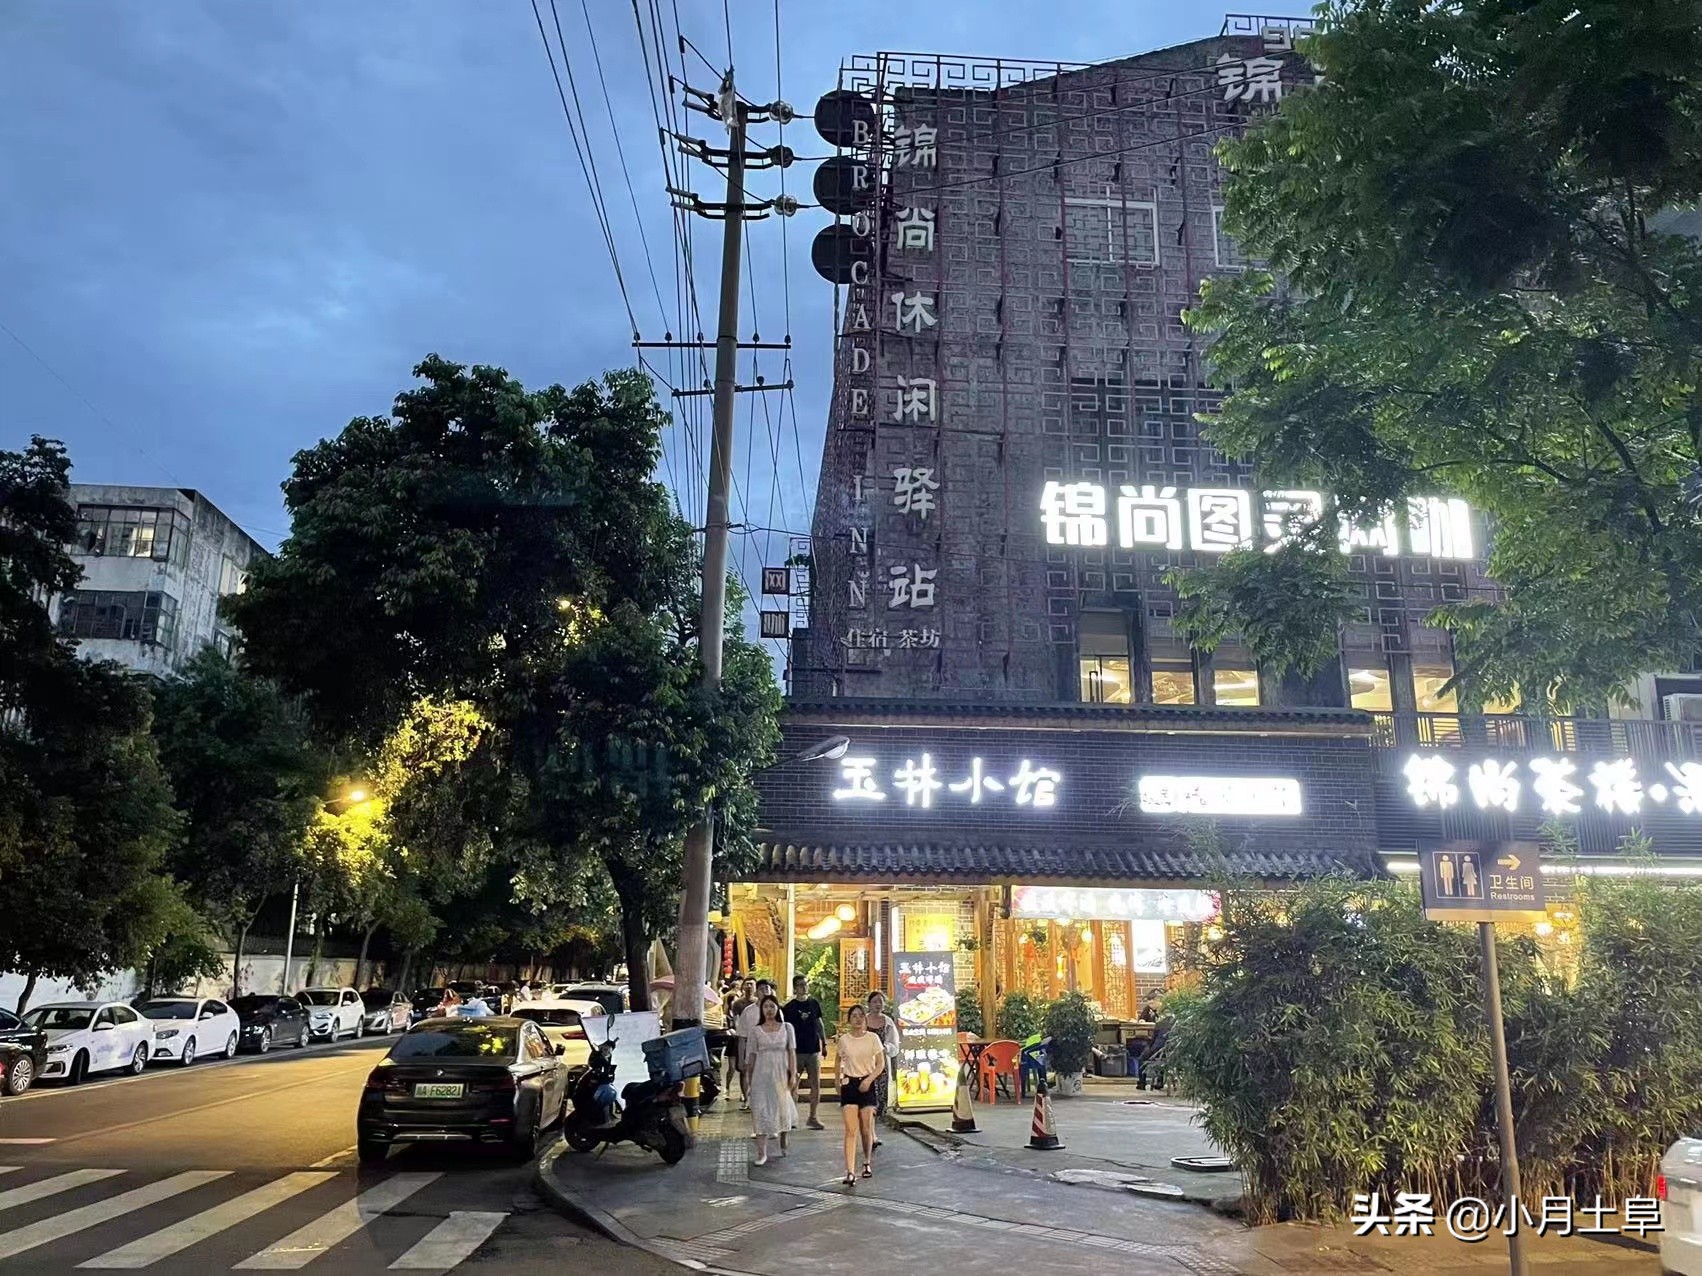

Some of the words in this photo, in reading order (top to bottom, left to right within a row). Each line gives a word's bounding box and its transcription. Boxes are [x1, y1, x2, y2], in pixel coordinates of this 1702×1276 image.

[850, 119, 871, 417] BROCADE
[889, 124, 940, 608] 锦尚休闲驿站
[848, 475, 867, 608] INN
[898, 629, 940, 649] 茶坊
[832, 753, 1062, 808] 玉林小馆
[1489, 874, 1534, 890] 卫生间
[1490, 891, 1535, 901] Restrooms
